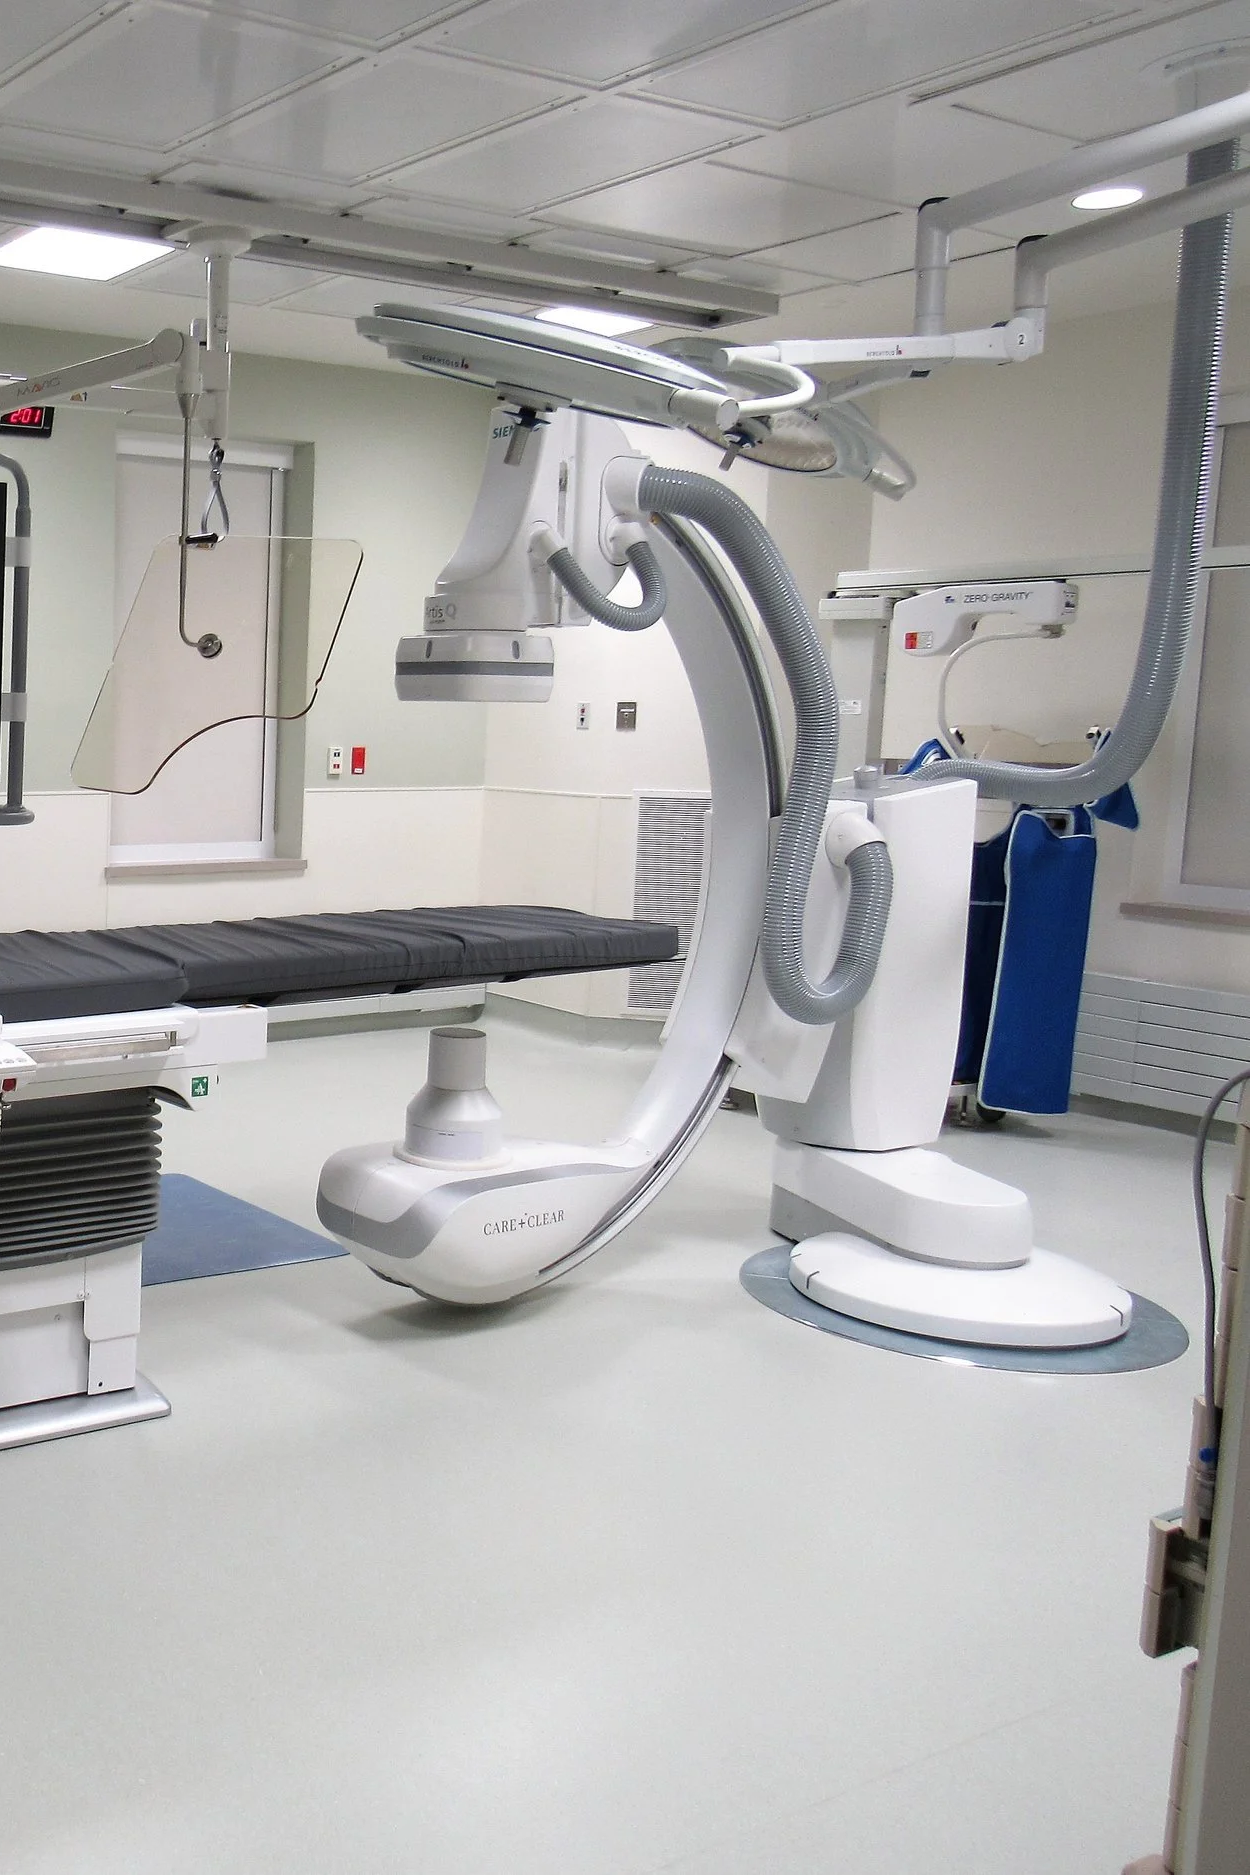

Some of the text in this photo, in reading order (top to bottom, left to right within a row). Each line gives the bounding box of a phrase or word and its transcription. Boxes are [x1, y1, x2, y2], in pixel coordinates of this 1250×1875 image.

[1018, 334, 1025, 345] 2
[9, 407, 42, 424] 2:01
[445, 602, 457, 621] Q
[483, 1209, 565, 1236] CARE+CLEAR
